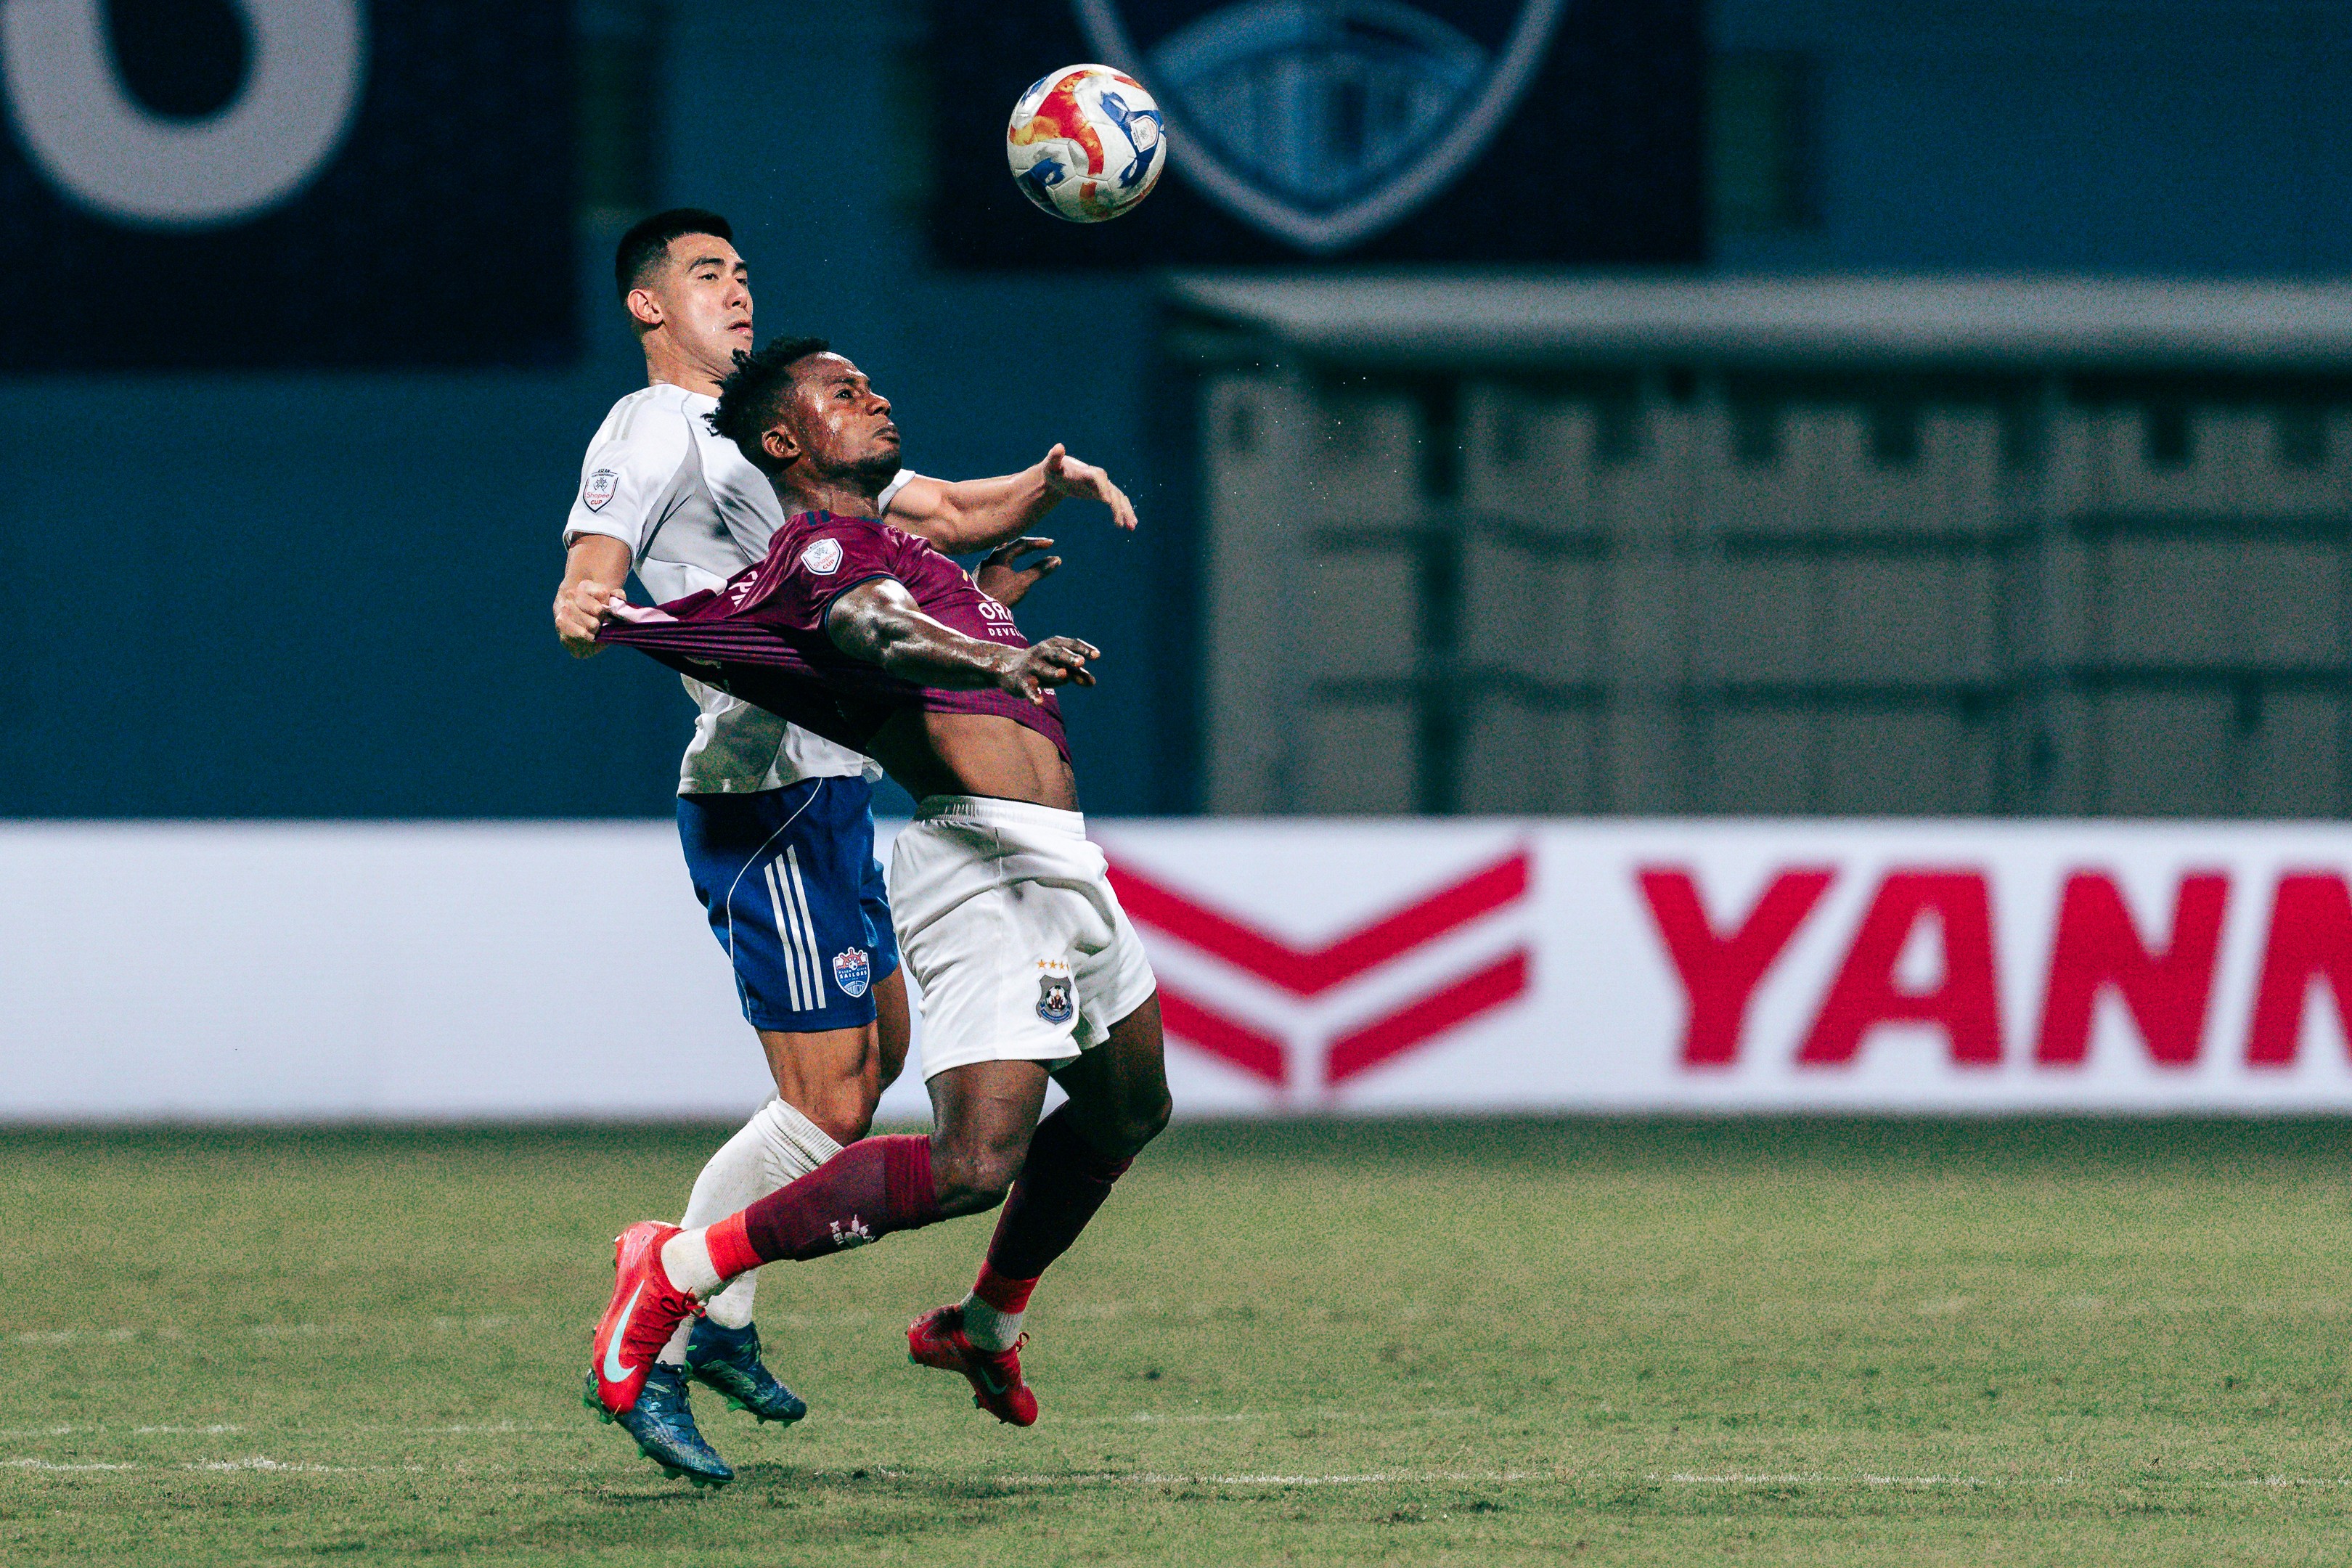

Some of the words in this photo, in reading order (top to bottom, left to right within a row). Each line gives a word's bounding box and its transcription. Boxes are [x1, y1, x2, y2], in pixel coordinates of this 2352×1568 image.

[813, 551, 837, 568] Shopee
[822, 559, 835, 570] CUP
[839, 970, 867, 979] SAILORS
